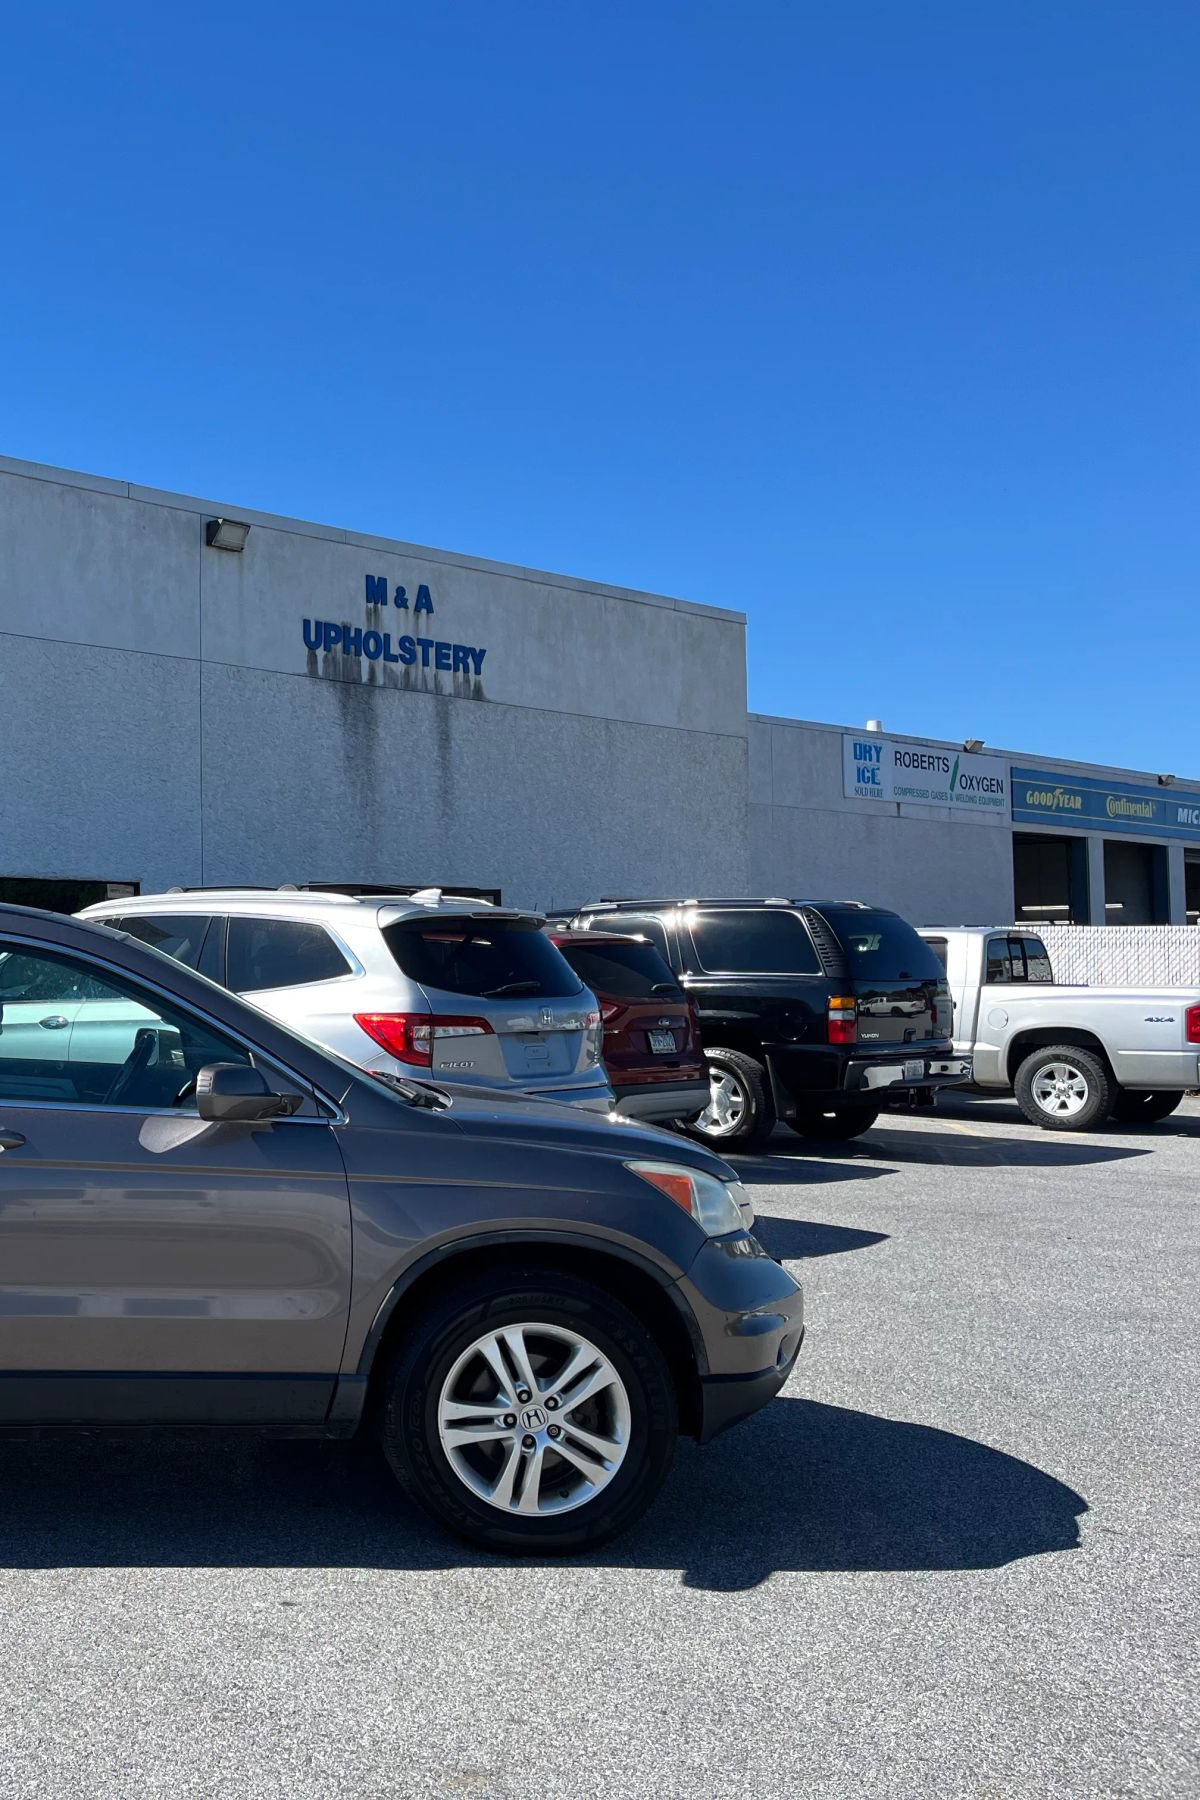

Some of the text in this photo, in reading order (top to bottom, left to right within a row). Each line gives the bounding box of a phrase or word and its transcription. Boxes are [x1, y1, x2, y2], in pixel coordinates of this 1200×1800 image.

[366, 575, 434, 614] M & A
[303, 619, 487, 676] UPHOLSTERY
[853, 742, 882, 764] DRY
[856, 766, 881, 786] ICE
[894, 751, 1004, 794] ROBERTS OXYGEN
[1026, 788, 1082, 810] GOODYEAR
[1106, 795, 1153, 818] Continental
[1177, 807, 1200, 824] MIC
